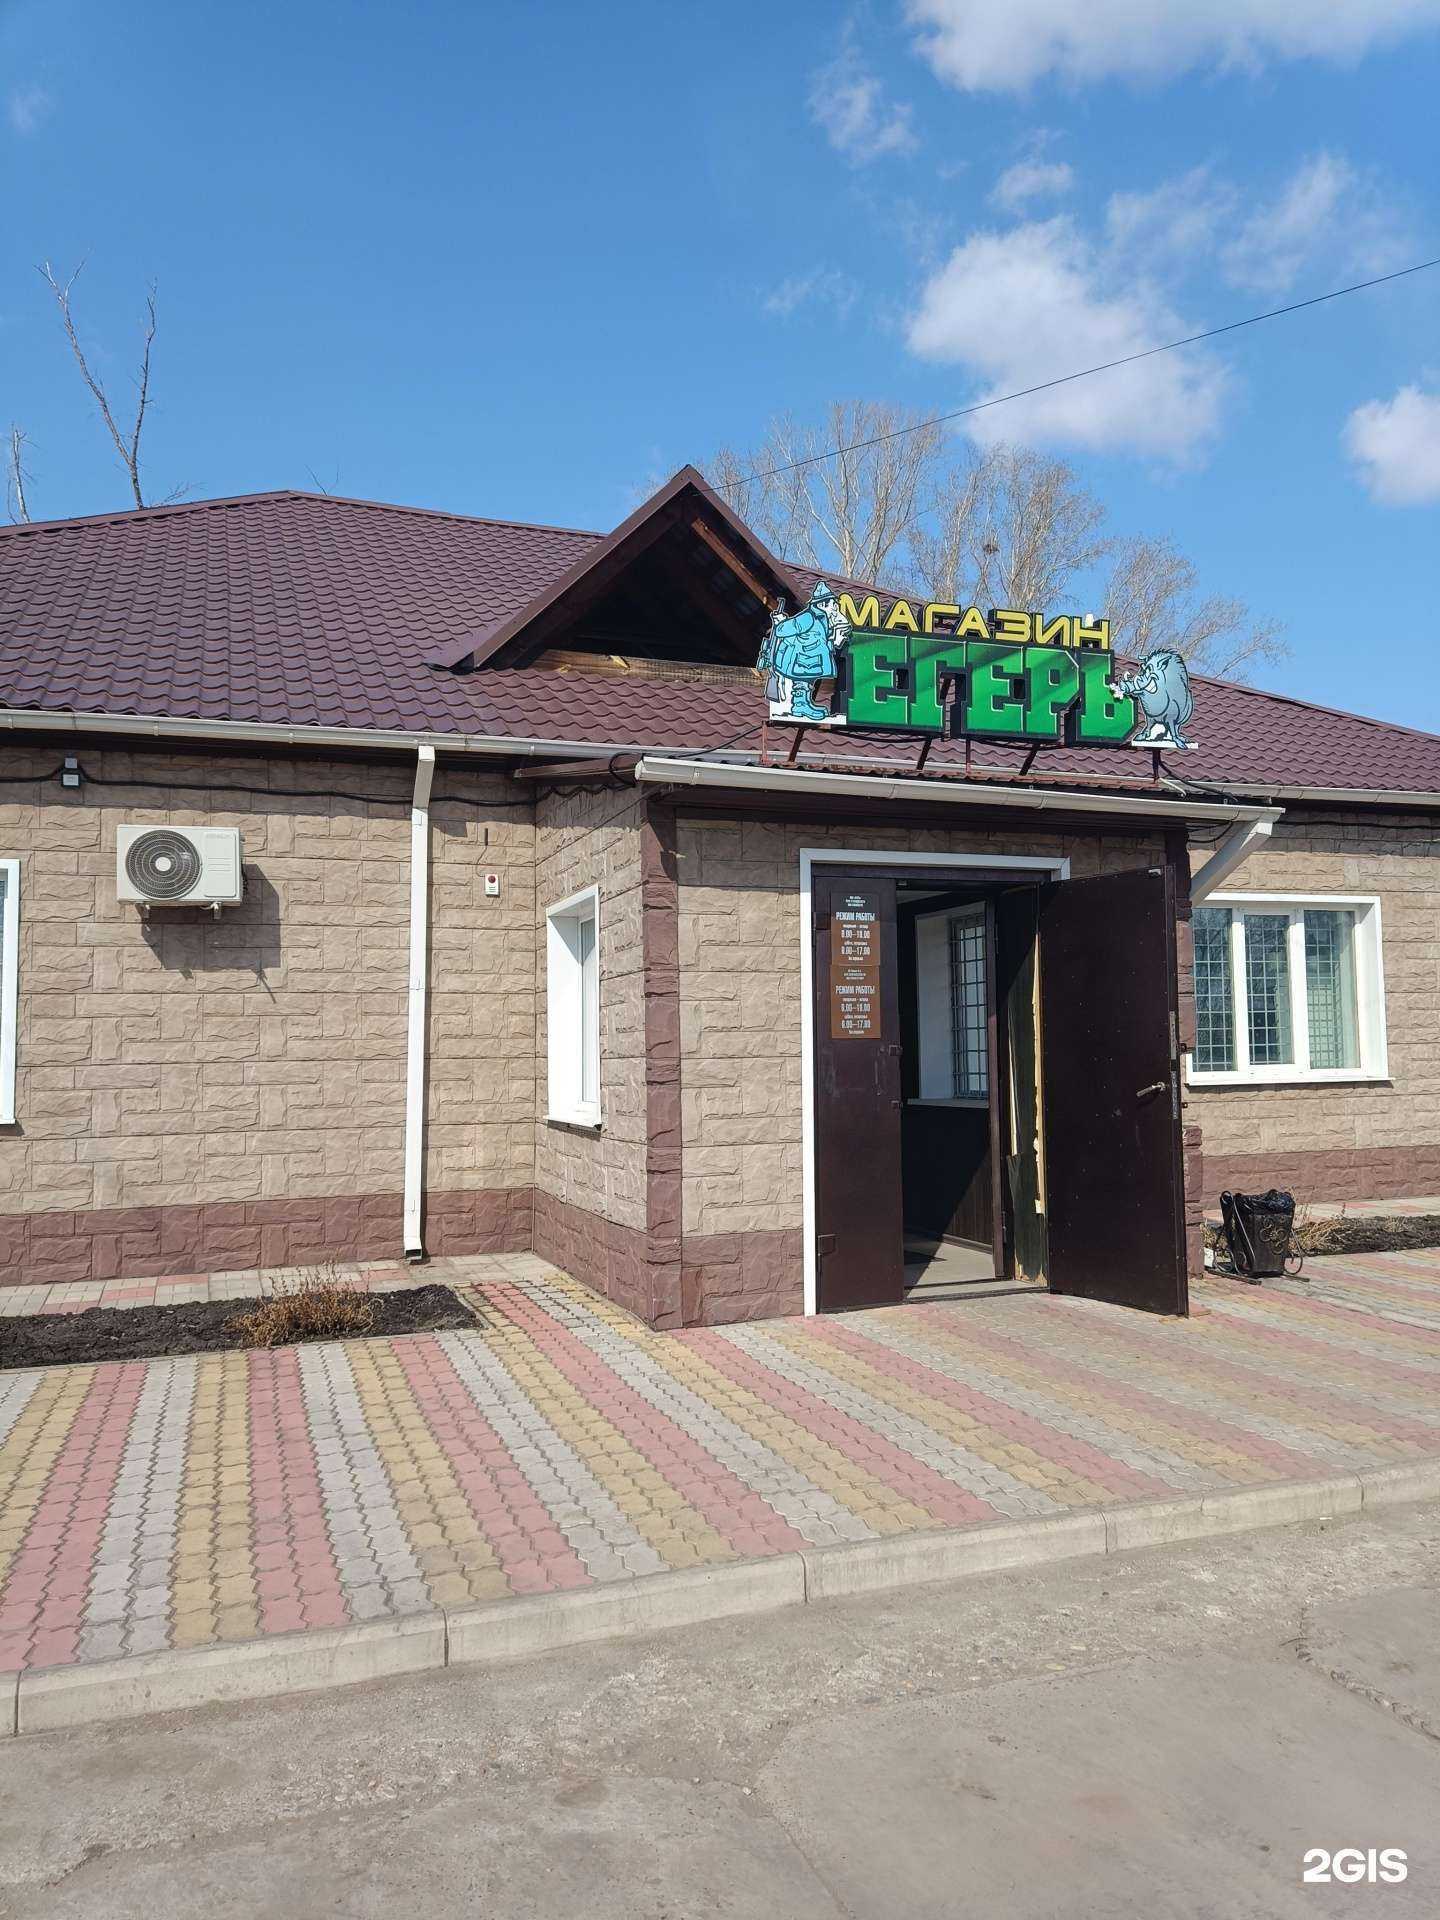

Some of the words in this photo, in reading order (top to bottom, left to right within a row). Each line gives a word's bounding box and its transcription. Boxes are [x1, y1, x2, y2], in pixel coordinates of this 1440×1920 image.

[839, 592, 1111, 649] МАГАЗИН
[847, 631, 1138, 742] ЕГЕРЬ
[835, 911, 855, 921] РЕЖИМ
[855, 912, 876, 922] РАБОТЫ
[835, 985, 855, 995] РЕЖИМ
[855, 985, 876, 995] РАБОТЫ
